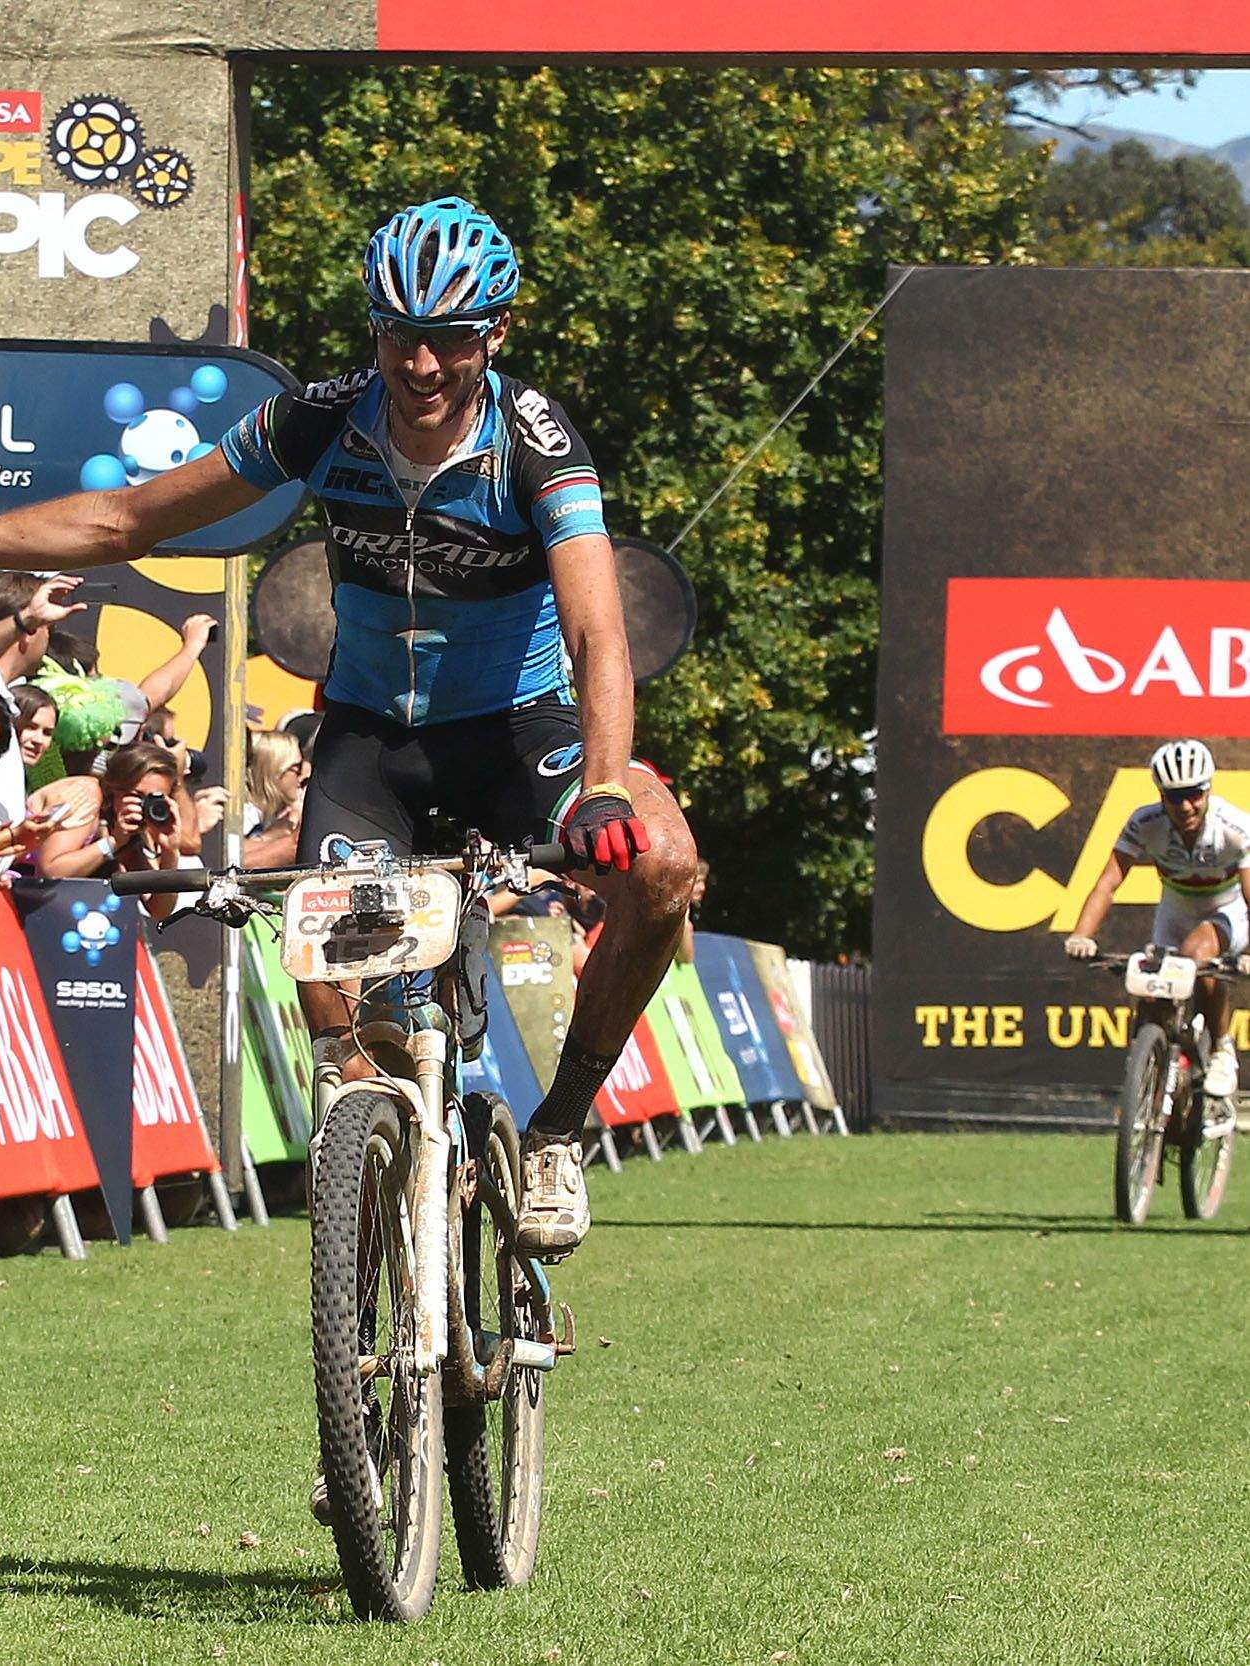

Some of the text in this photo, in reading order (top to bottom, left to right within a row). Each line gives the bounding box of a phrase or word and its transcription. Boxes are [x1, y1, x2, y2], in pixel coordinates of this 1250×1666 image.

[332, 525, 530, 568] ORPADO
[353, 553, 472, 579] FACTORY
[915, 1005, 1024, 1049] THE
